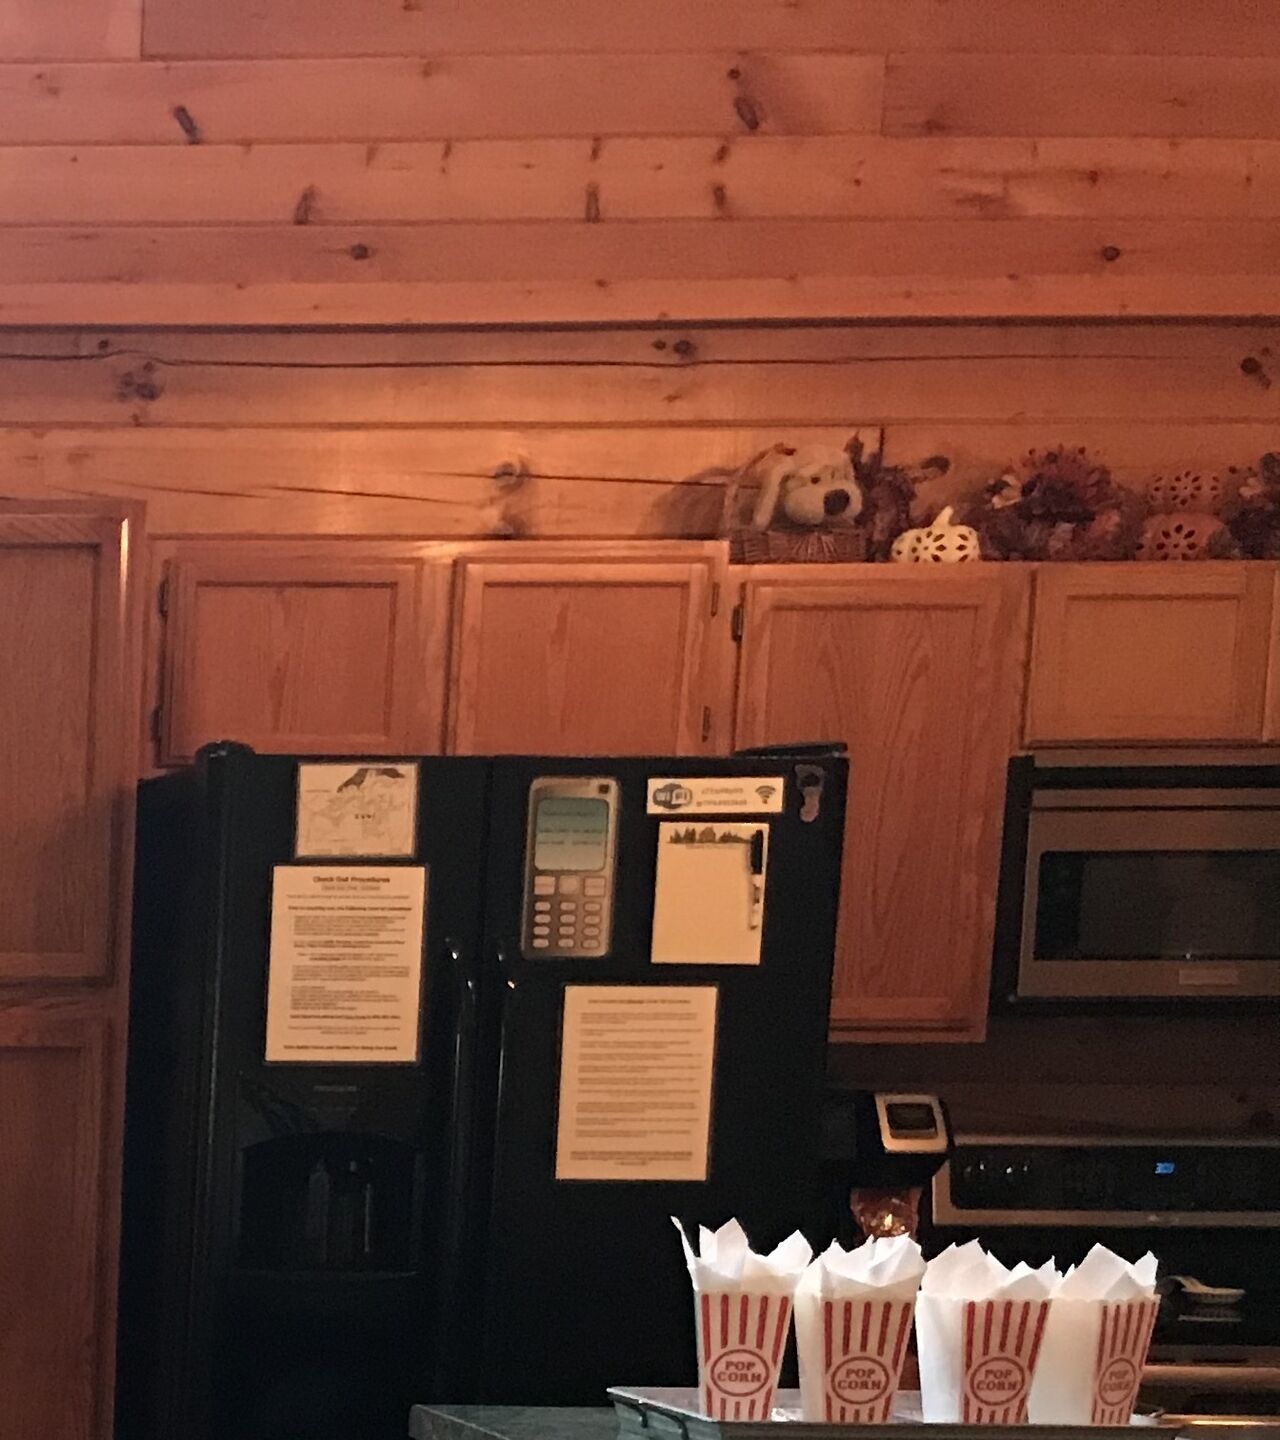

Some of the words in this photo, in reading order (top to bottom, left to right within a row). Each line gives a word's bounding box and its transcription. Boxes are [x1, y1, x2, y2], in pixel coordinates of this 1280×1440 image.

[725, 1360, 756, 1372] POP
[717, 1371, 762, 1383] CORN
[845, 1368, 876, 1378] POP
[984, 1369, 1013, 1379] POP
[837, 1379, 882, 1391] CORN
[976, 1380, 1018, 1391] CORN
